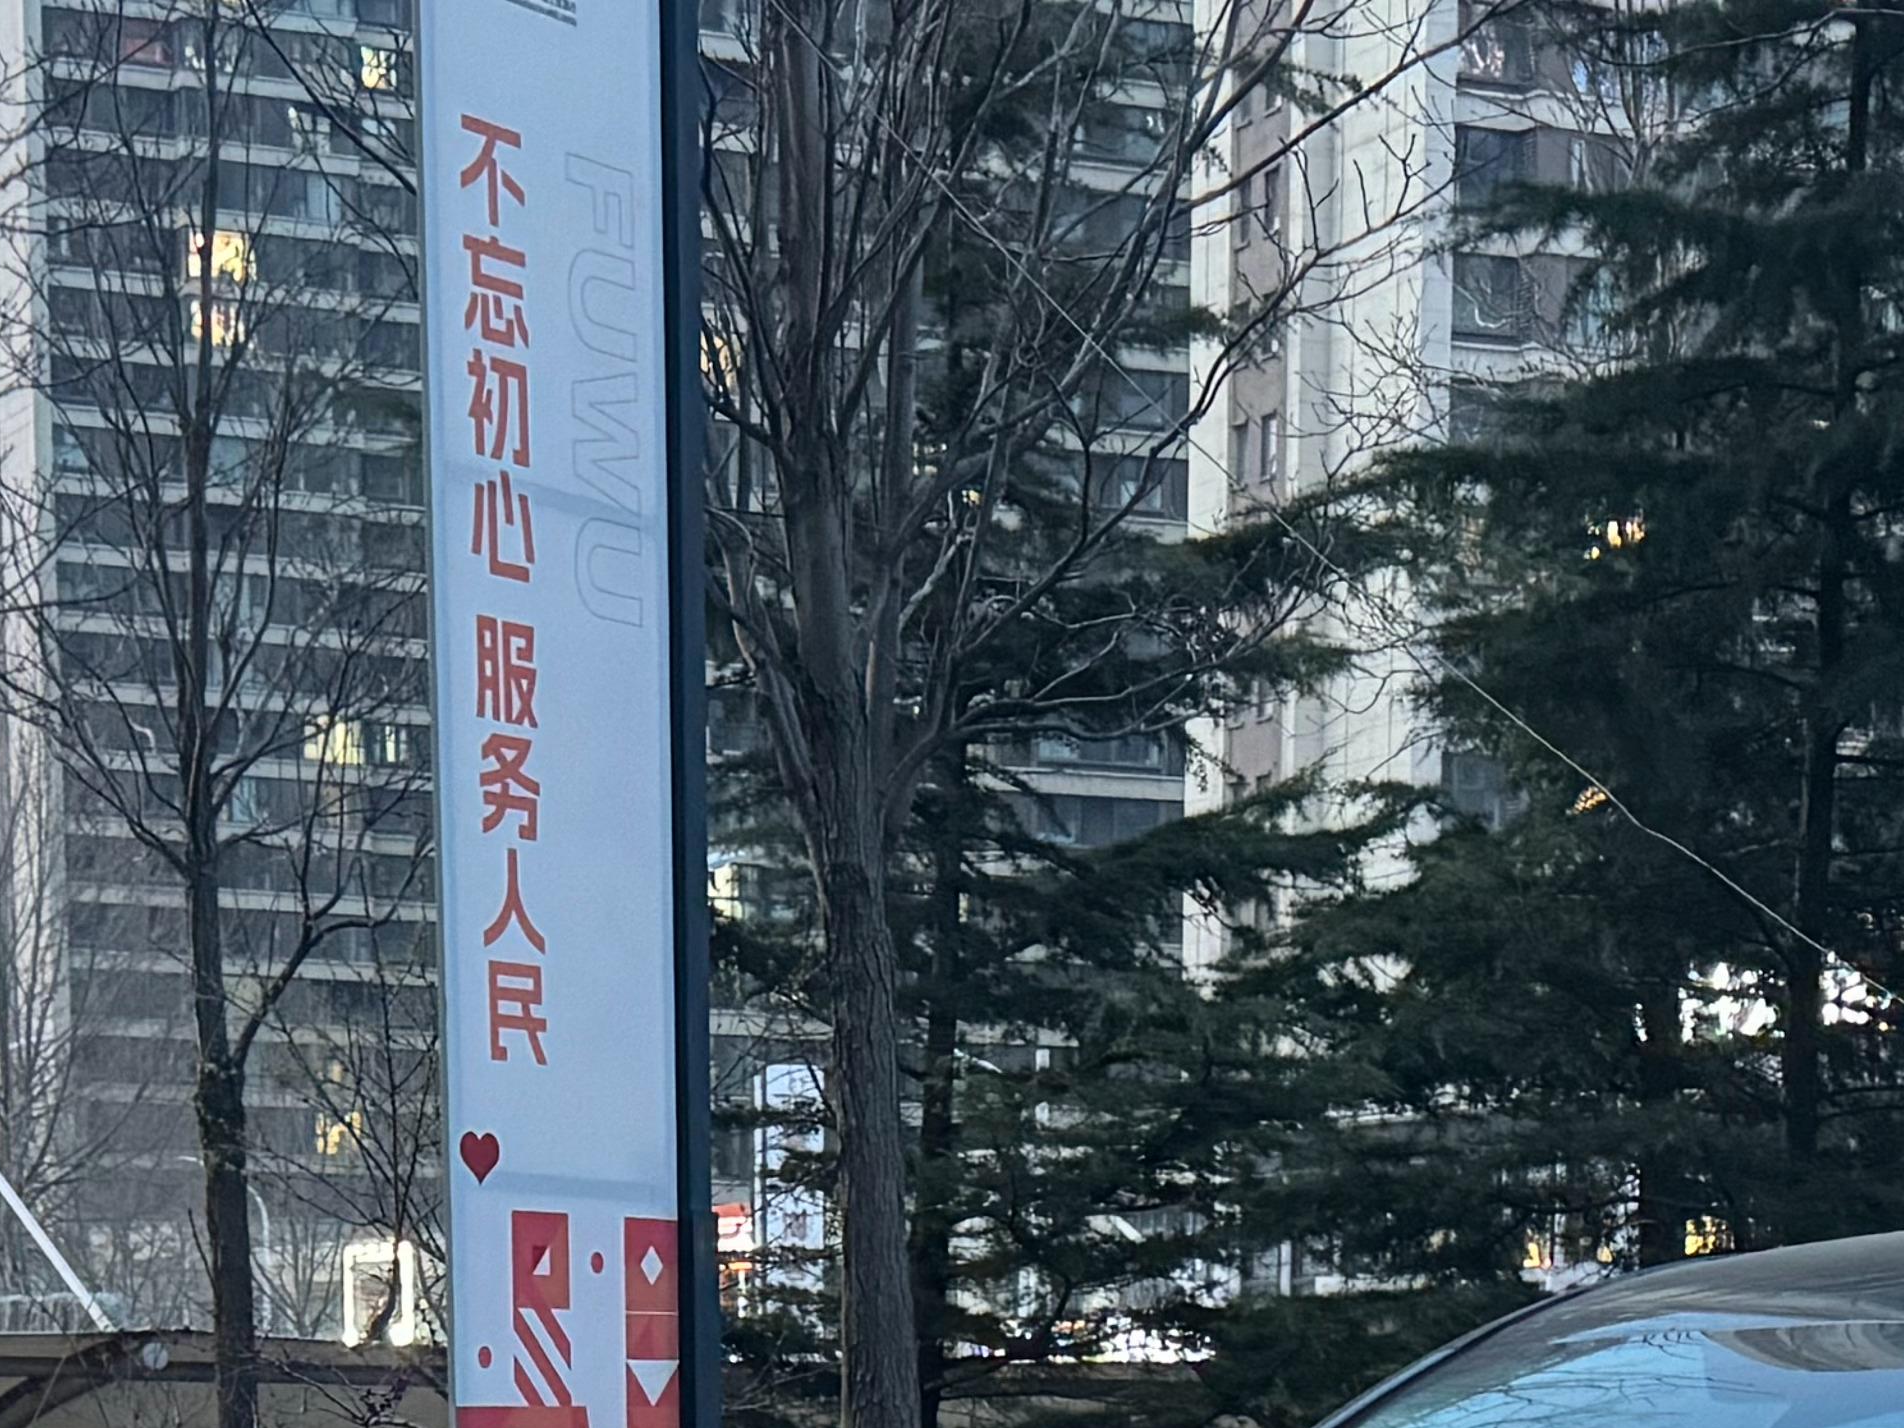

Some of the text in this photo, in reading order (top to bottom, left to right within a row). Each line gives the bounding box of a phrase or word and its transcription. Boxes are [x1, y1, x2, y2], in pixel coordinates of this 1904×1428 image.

[459, 112, 549, 1067] 不忘初心 服务人民
[564, 151, 645, 628] FUWU
